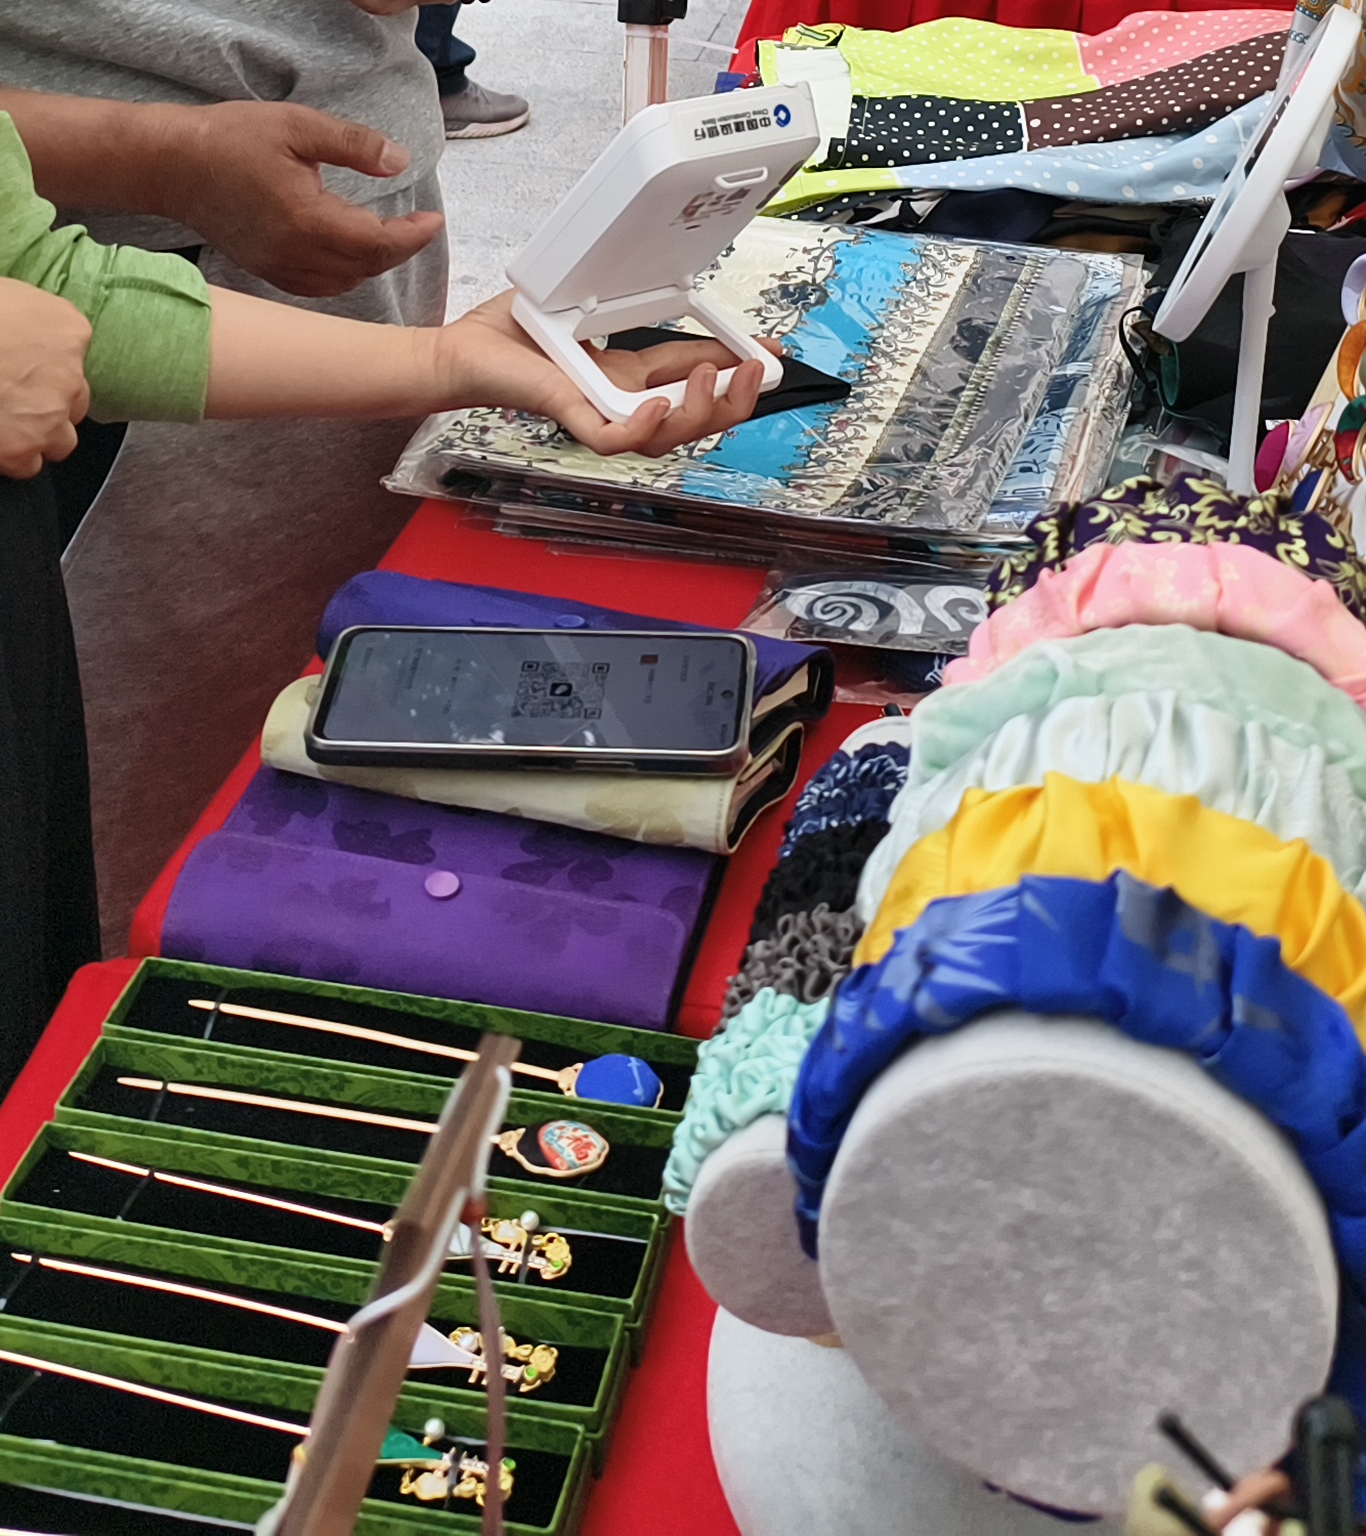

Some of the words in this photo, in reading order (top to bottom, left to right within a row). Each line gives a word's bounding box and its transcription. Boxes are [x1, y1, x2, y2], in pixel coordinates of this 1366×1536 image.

[694, 116, 771, 141] 中国建设银行
